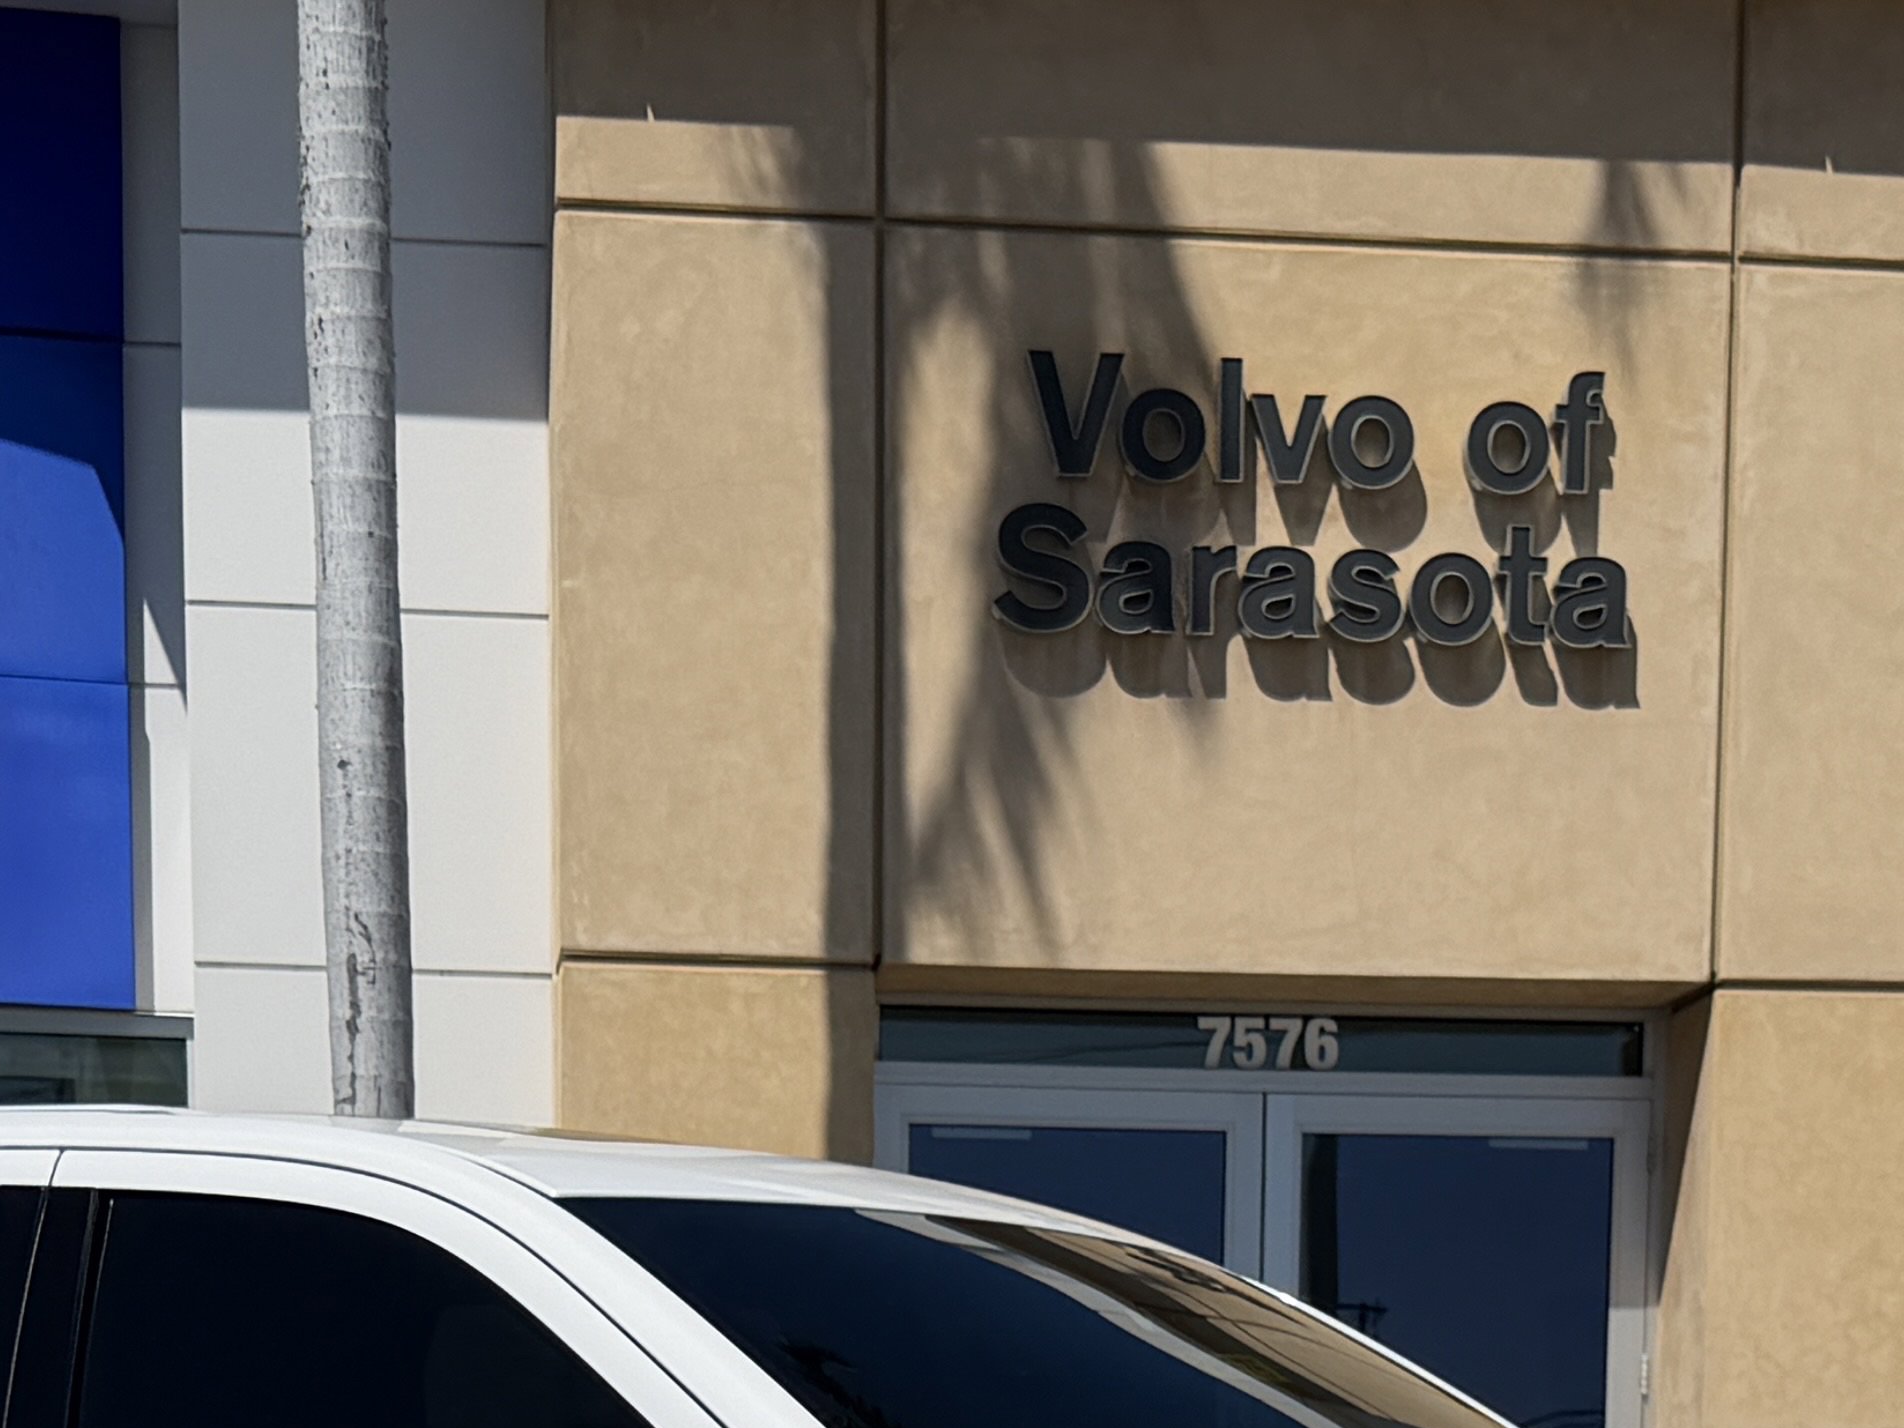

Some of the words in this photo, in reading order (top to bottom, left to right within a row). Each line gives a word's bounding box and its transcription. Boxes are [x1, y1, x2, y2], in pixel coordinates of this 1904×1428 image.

[1026, 349, 1416, 490] Volvo
[1463, 371, 1607, 495] of
[992, 501, 1632, 648] Sarasota
[1197, 1015, 1339, 1071] 7576
